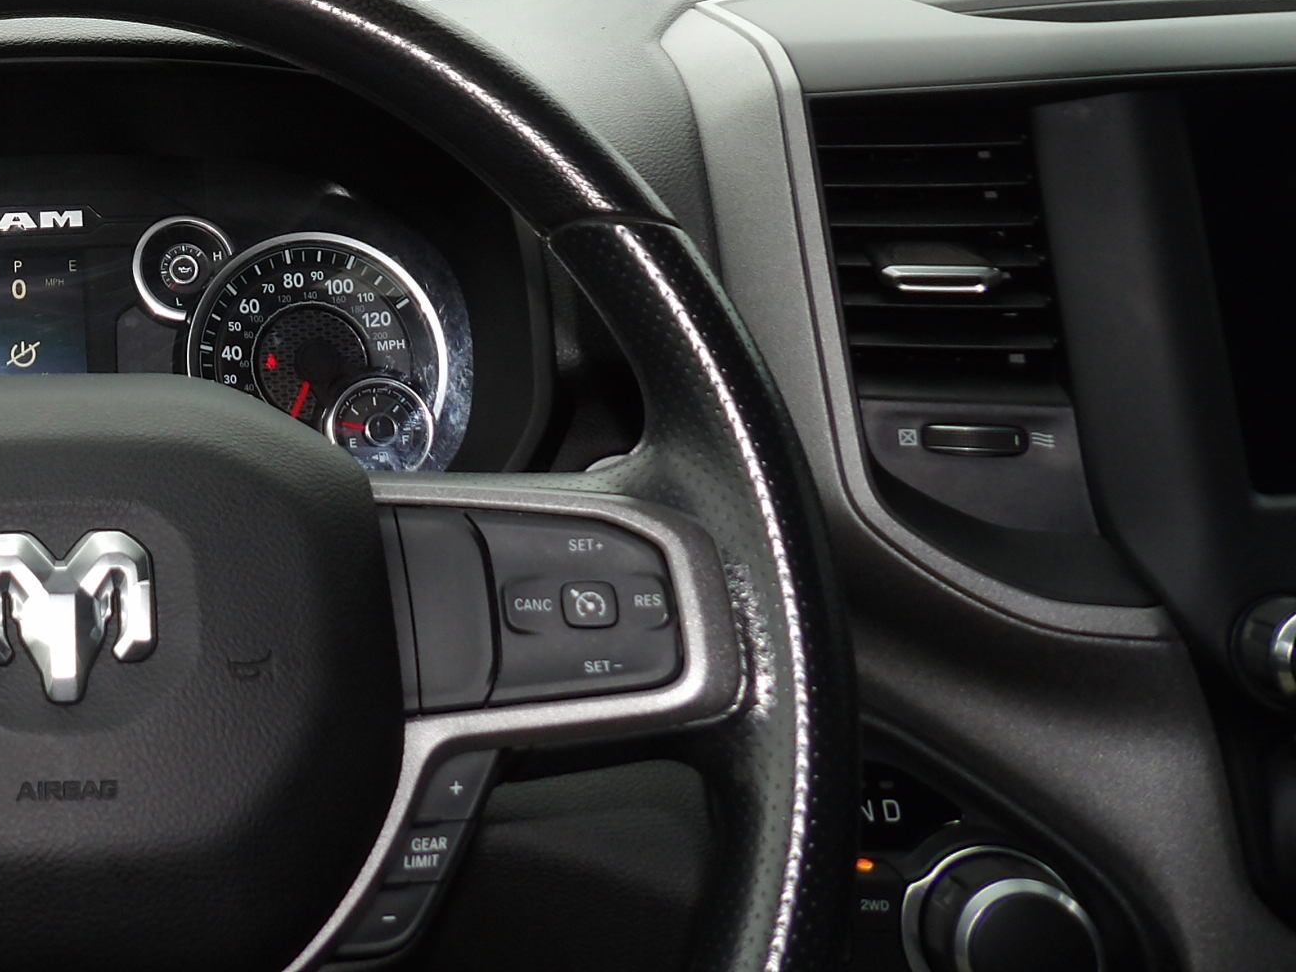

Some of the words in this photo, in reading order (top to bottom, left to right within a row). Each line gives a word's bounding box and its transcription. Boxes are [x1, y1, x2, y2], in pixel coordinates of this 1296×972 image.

[212, 250, 223, 262] H
[13, 260, 23, 274] P
[68, 259, 78, 272] E
[45, 278, 65, 287] MPH
[282, 272, 304, 289] 80
[310, 270, 324, 281] 90
[11, 278, 28, 300] 0
[261, 283, 275, 294] 70
[324, 279, 354, 295] 100
[175, 297, 183, 306] L
[356, 292, 375, 303] 110
[239, 298, 260, 314] 60
[227, 321, 242, 332] 50
[361, 311, 391, 328] 120
[376, 338, 406, 352] MPH
[221, 345, 243, 361] 40
[223, 374, 237, 385] 30
[348, 437, 358, 449] E
[401, 434, 410, 445] F
[514, 597, 553, 614] CANC
[633, 593, 662, 608] RES
[15, 779, 118, 802] AIRBAG
[880, 798, 902, 823] D
[410, 835, 449, 851] GEAR
[404, 853, 440, 869] LIMIT
[859, 898, 890, 913] 2WD
